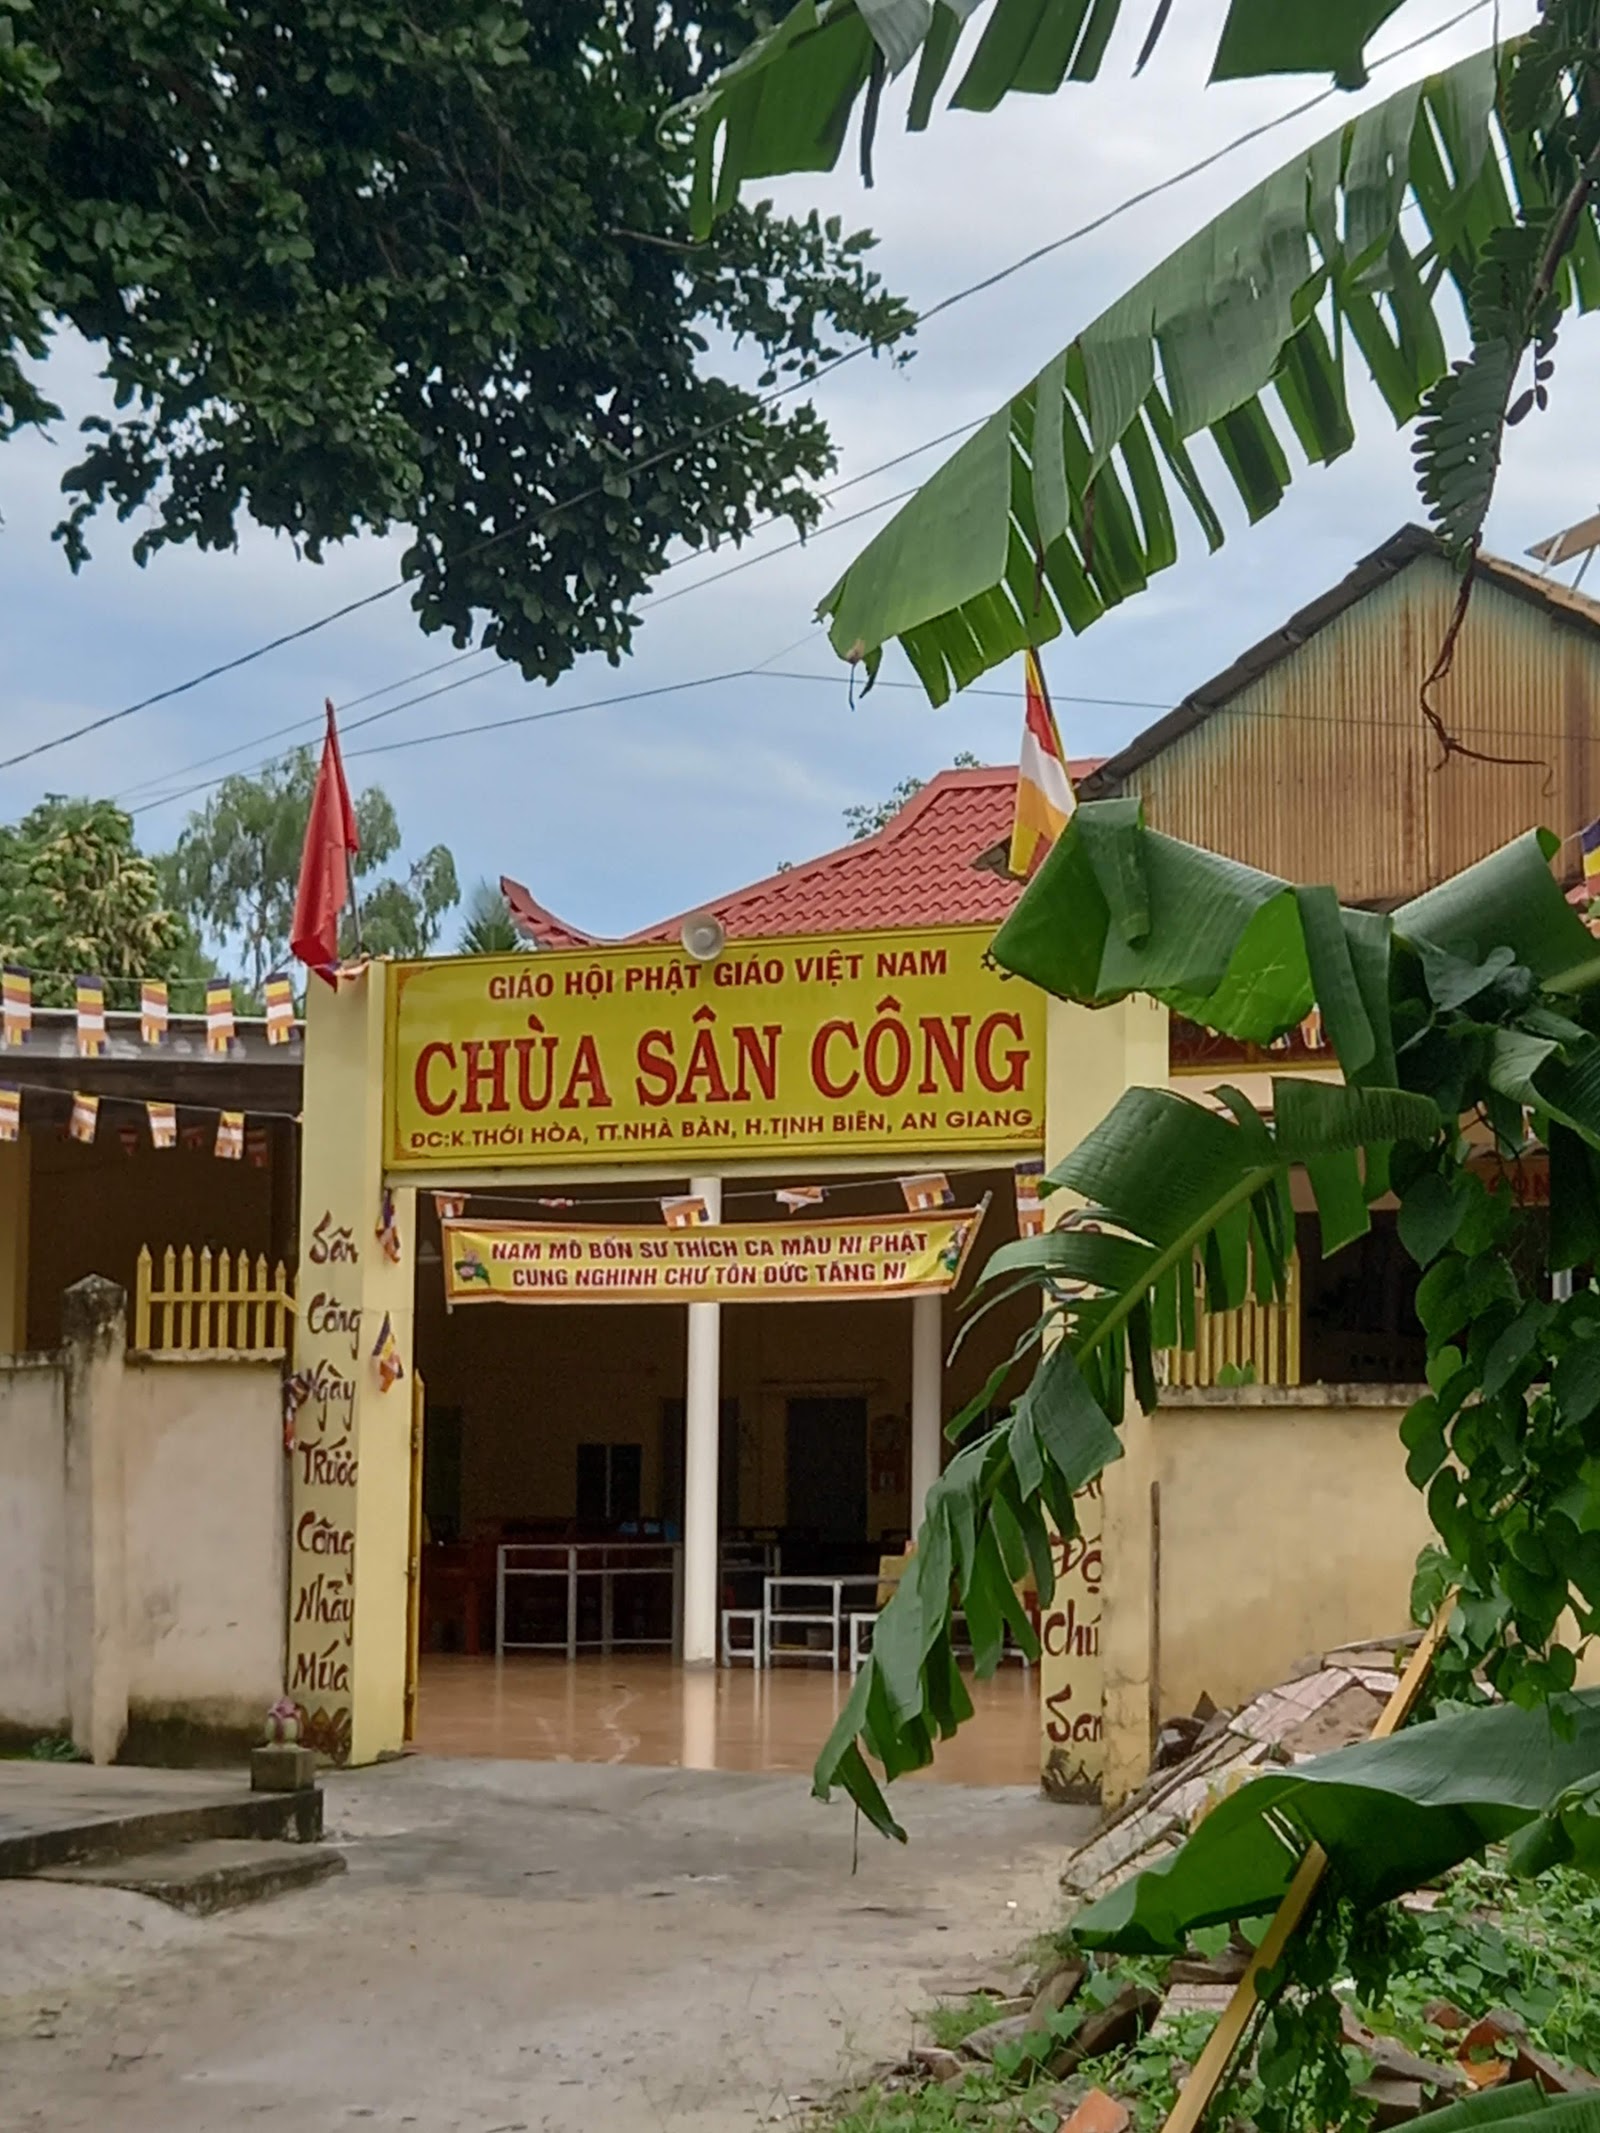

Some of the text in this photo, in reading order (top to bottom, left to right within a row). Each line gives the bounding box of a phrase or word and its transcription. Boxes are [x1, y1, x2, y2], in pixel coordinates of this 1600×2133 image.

[489, 949, 947, 1000] GIÁO HỘI PHẬT GIÁO VIỆT NAM
[414, 994, 1031, 1117] CHÙA SÂN CÔNG
[531, 1121, 589, 1144] HÒA,
[745, 1113, 824, 1140] H.TỊNH
[832, 1110, 893, 1134] BIÊN,
[901, 1112, 937, 1130] AN
[945, 1108, 1033, 1128] GIANG
[491, 1242, 541, 1260] NAM
[549, 1239, 583, 1259] MÔ
[640, 1241, 669, 1258] SƯ
[674, 1237, 738, 1258] THÍCH
[744, 1241, 774, 1256] CA
[839, 1237, 863, 1253] NI
[868, 1231, 929, 1256] PHẬT
[513, 1268, 568, 1287] CUNG
[575, 1267, 657, 1286] NGHINH
[664, 1265, 711, 1285] CHƯ
[716, 1263, 756, 1284] TÔN
[883, 1262, 907, 1279] NI
[292, 1639, 351, 1693] Múa
